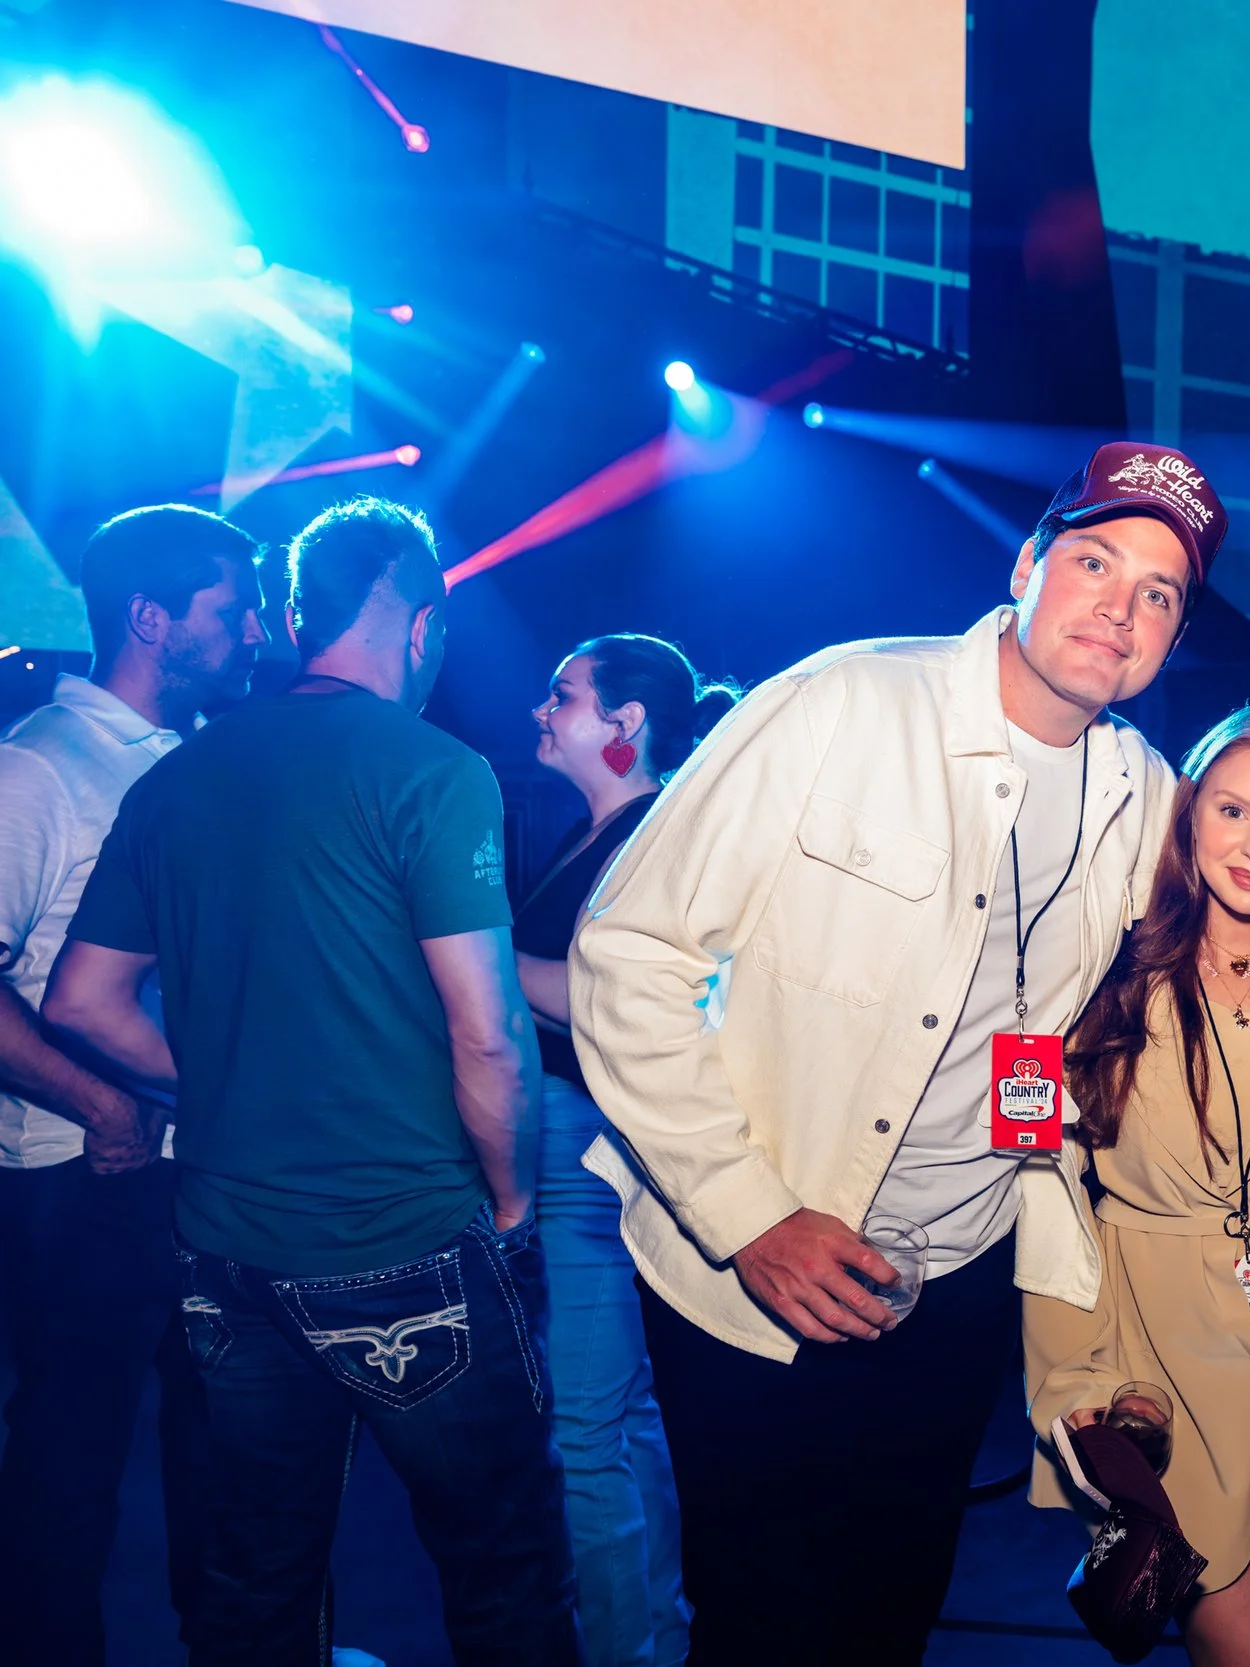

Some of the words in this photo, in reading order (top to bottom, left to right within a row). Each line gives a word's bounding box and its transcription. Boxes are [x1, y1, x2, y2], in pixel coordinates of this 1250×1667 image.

[1157, 455, 1205, 490] Wild
[1151, 485, 1185, 508] RODEO
[1166, 480, 1214, 525] Heart
[1004, 1081, 1049, 1098] COUNTRY
